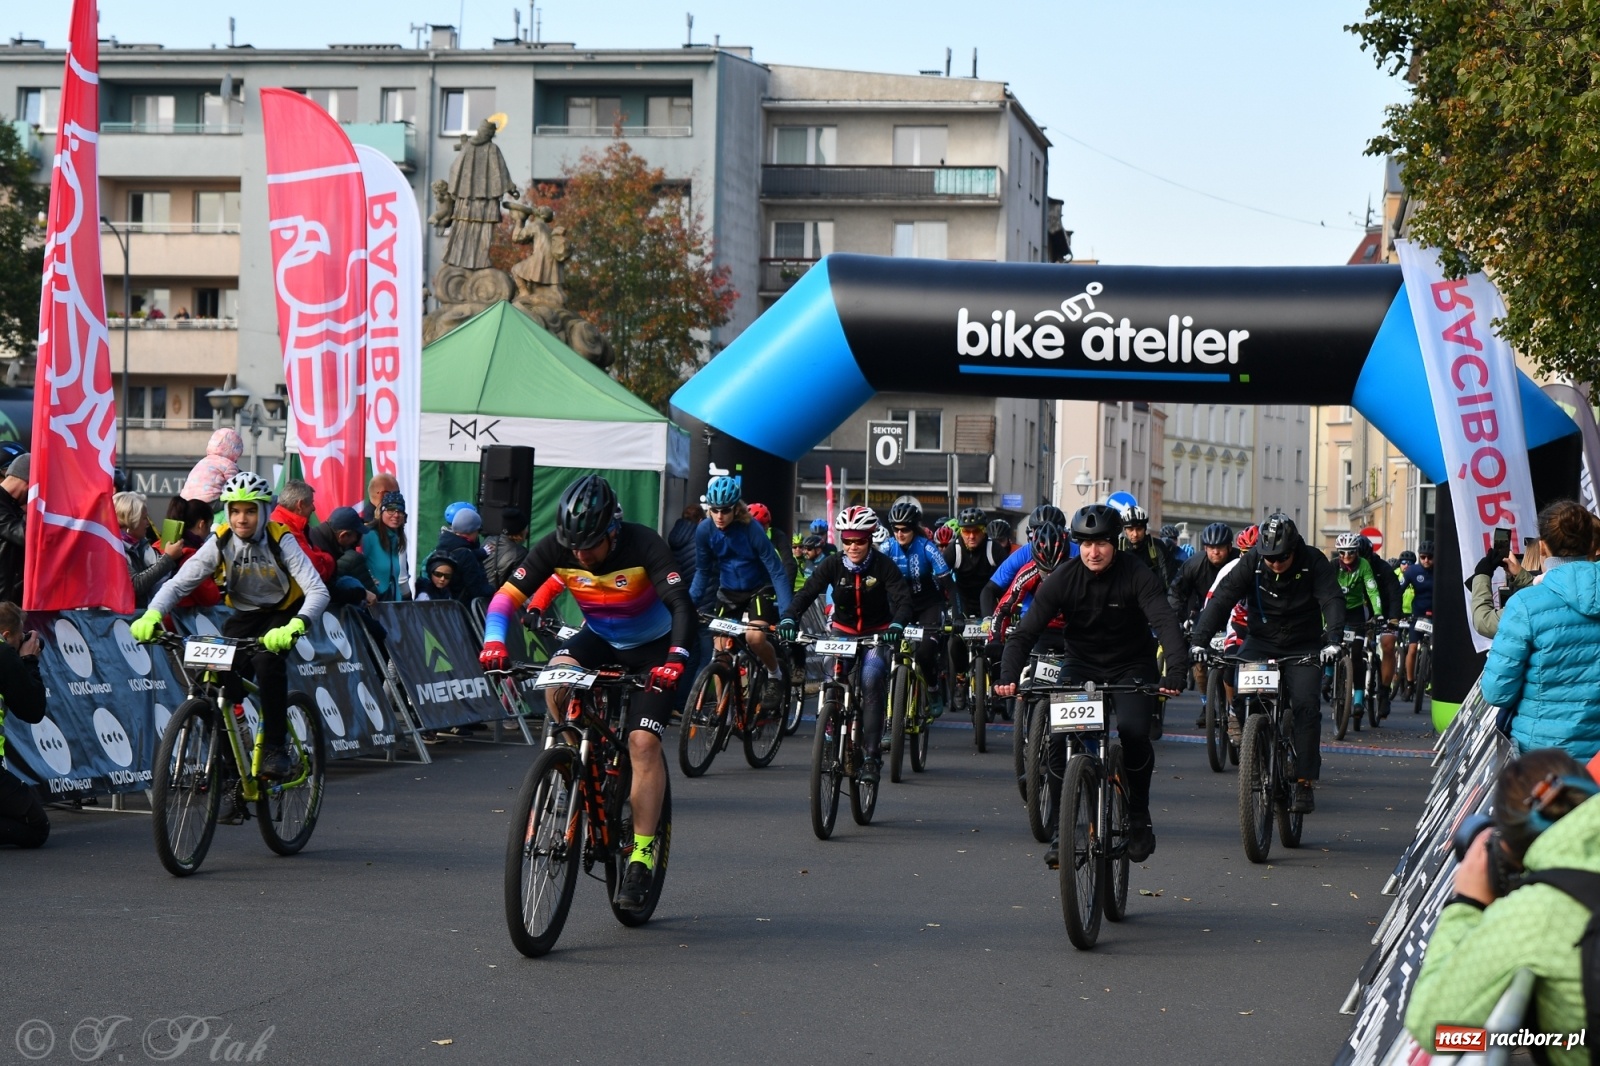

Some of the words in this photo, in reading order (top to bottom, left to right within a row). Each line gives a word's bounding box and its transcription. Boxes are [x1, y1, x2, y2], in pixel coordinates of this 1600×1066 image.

[957, 307, 1065, 360] bike
[1081, 314, 1250, 364] atelier
[873, 426, 902, 434] SEKTOR
[1269, 518, 1278, 533] FOX
[716, 621, 737, 631] 3286
[193, 646, 227, 659] 2479
[824, 643, 851, 651] 3247
[480, 650, 500, 658] FOX
[657, 666, 678, 676] FOX
[1244, 675, 1271, 685] 2151
[68, 682, 112, 695] KOKOwear
[1060, 706, 1095, 719] 2692
[109, 769, 153, 785] KOKOwear
[49, 777, 92, 793] KOKOwear
